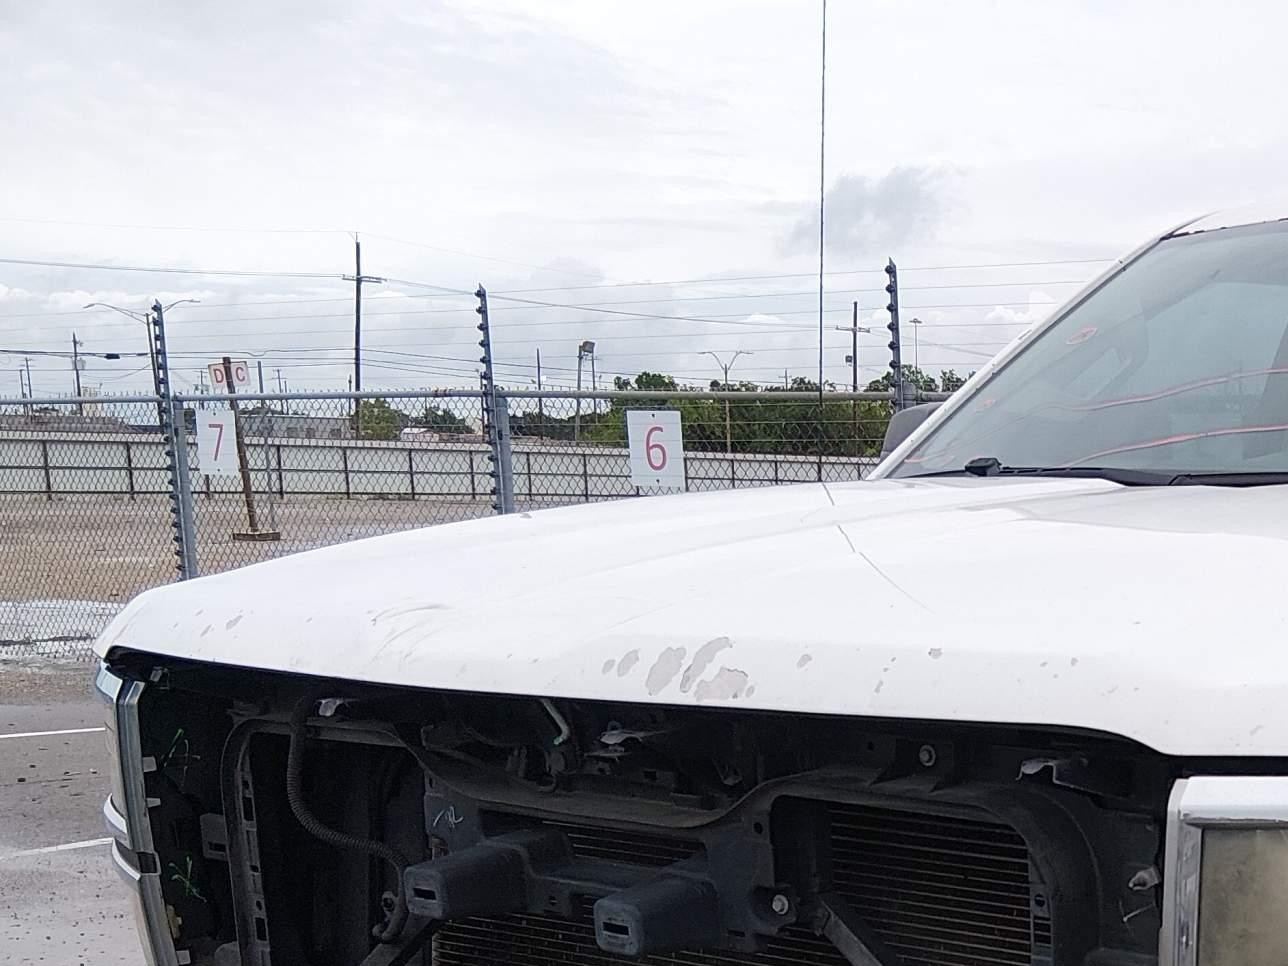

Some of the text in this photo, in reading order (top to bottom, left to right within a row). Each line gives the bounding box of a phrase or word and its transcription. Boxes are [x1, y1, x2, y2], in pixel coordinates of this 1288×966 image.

[212, 367, 225, 384] D
[235, 366, 246, 382] C
[208, 424, 223, 461] 7
[645, 426, 667, 471] 6
